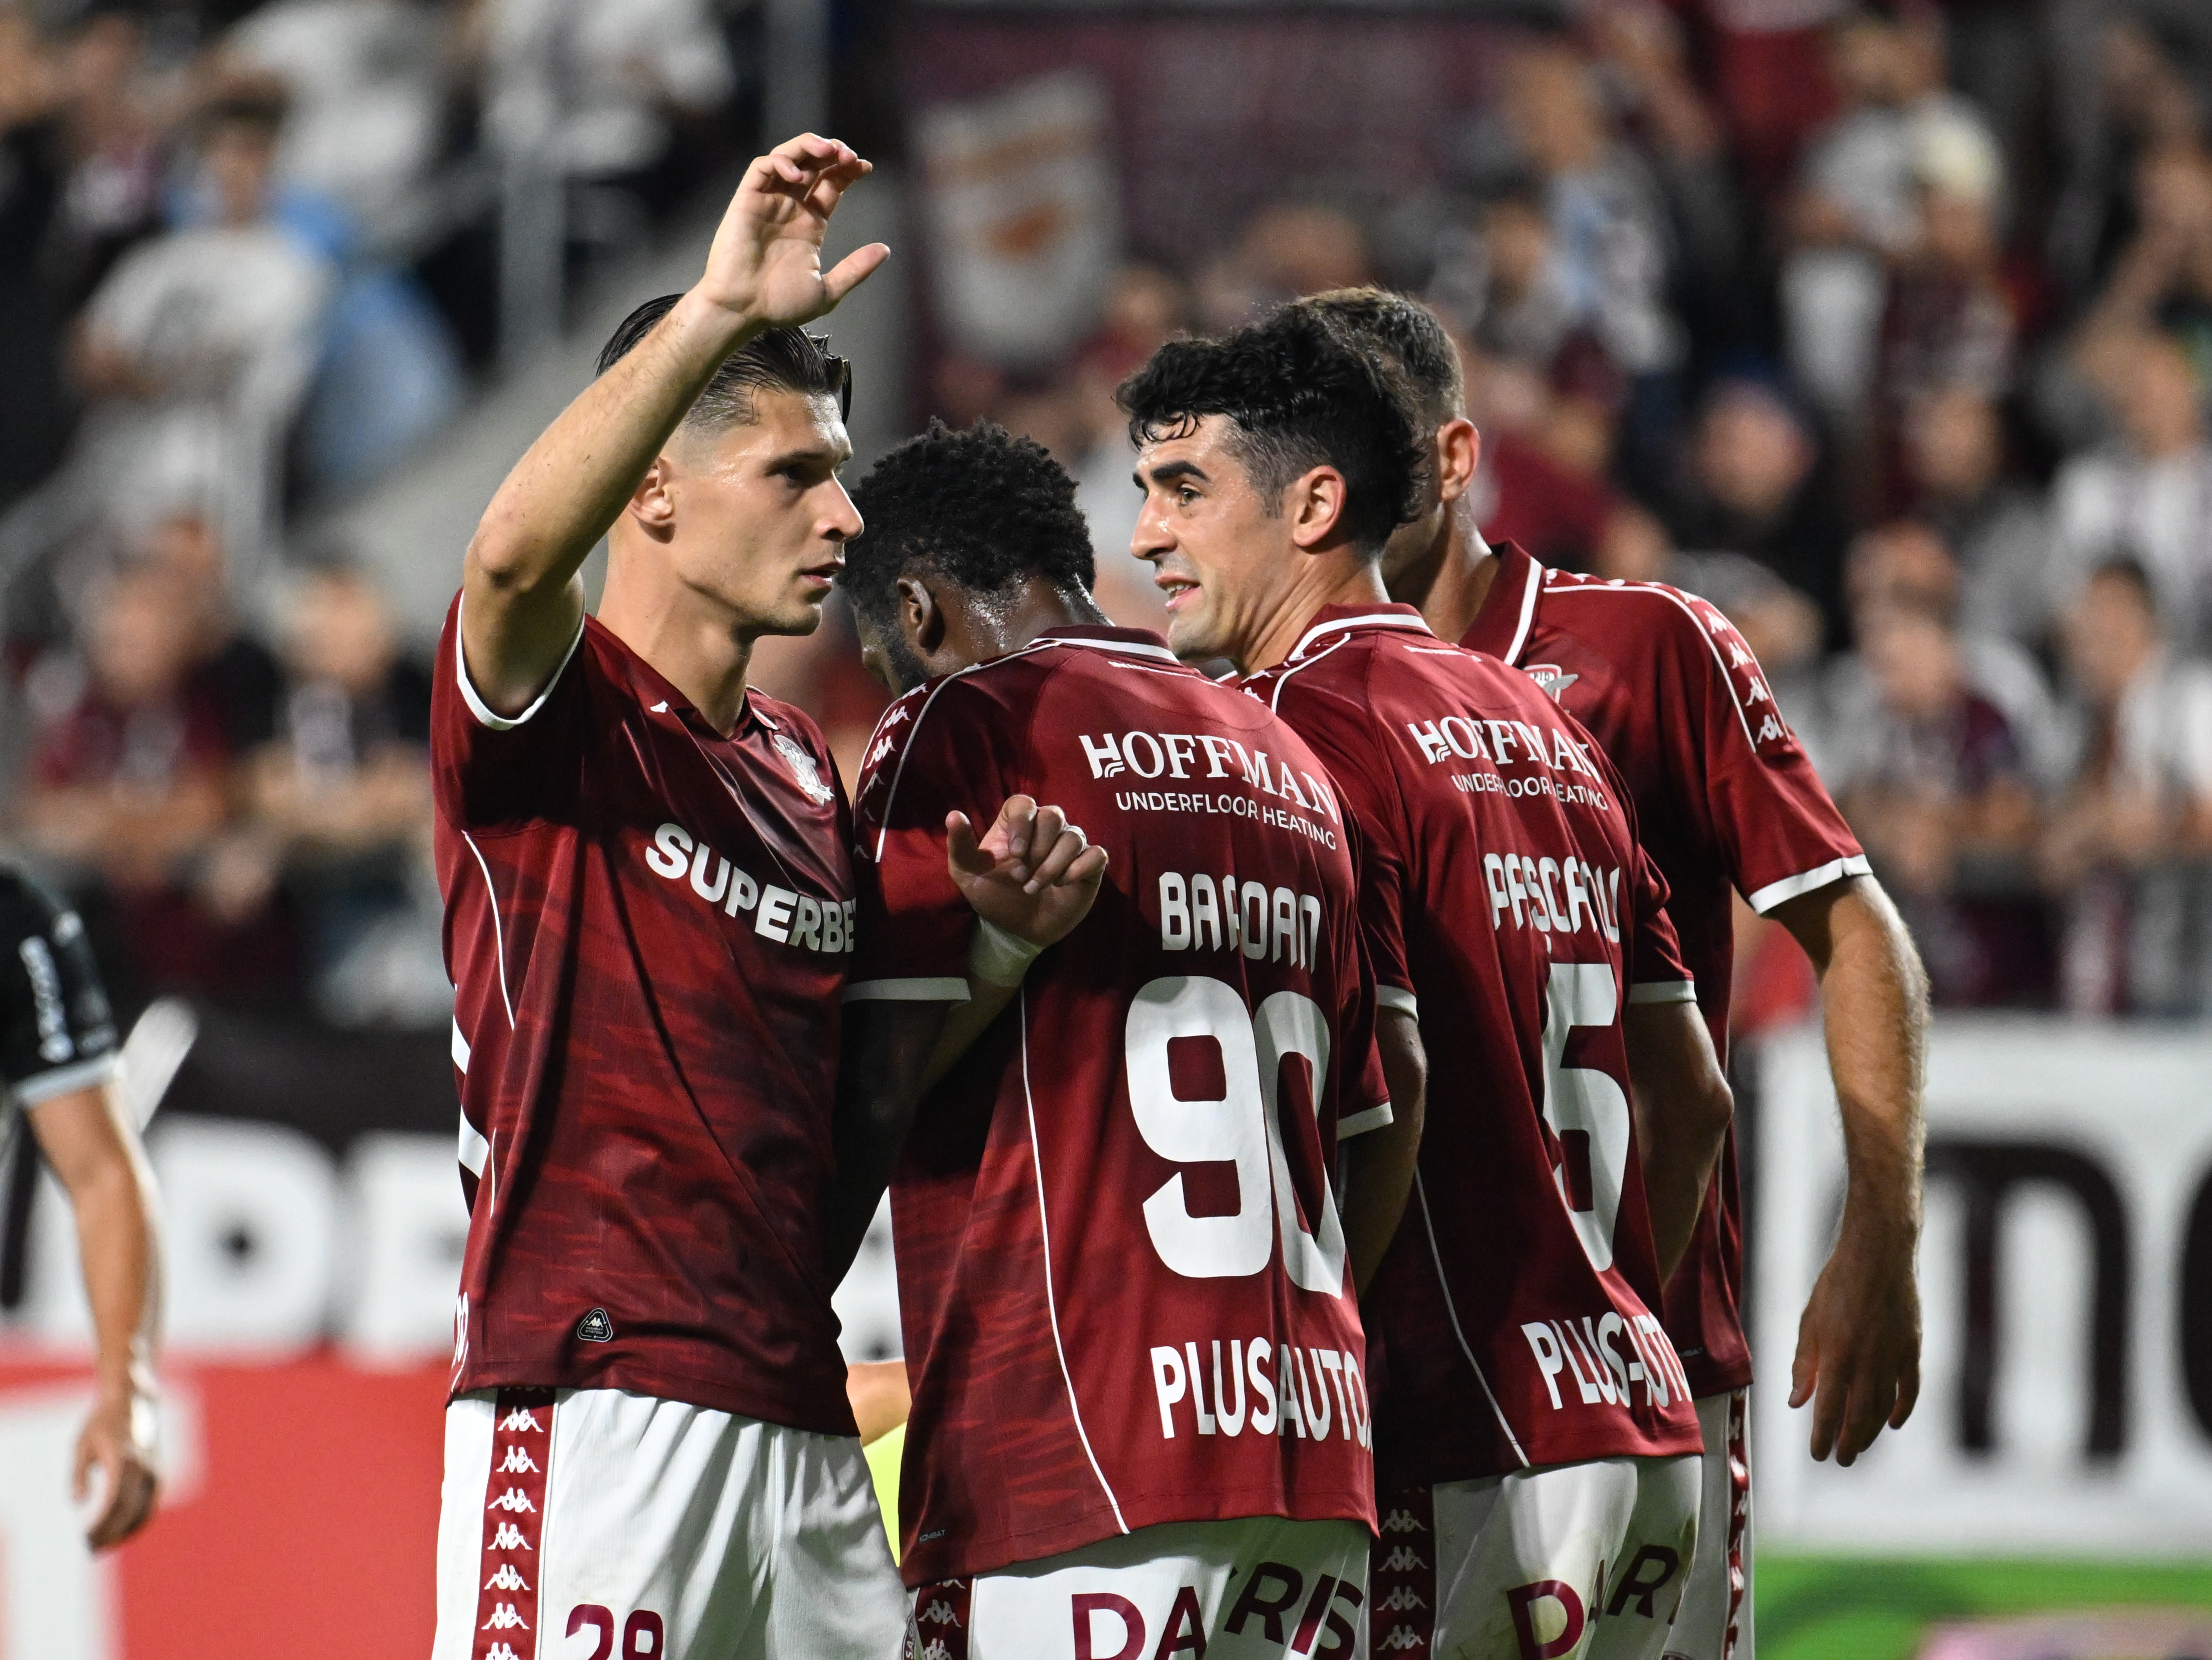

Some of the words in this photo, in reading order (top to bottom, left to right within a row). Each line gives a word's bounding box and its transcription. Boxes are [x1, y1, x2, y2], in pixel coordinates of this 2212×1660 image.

[1079, 731, 1339, 825] HOFFMAN
[1407, 716, 1601, 784] HOFFMAN
[1552, 782, 1608, 811] EATING
[1116, 792, 1258, 820] UNDERFLOOR
[1263, 805, 1337, 850] HEATING
[646, 823, 856, 953] SUPERBE
[1125, 976, 1345, 1299] 90
[1541, 963, 1630, 1272] 5
[1072, 1561, 1364, 1660] DARIS
